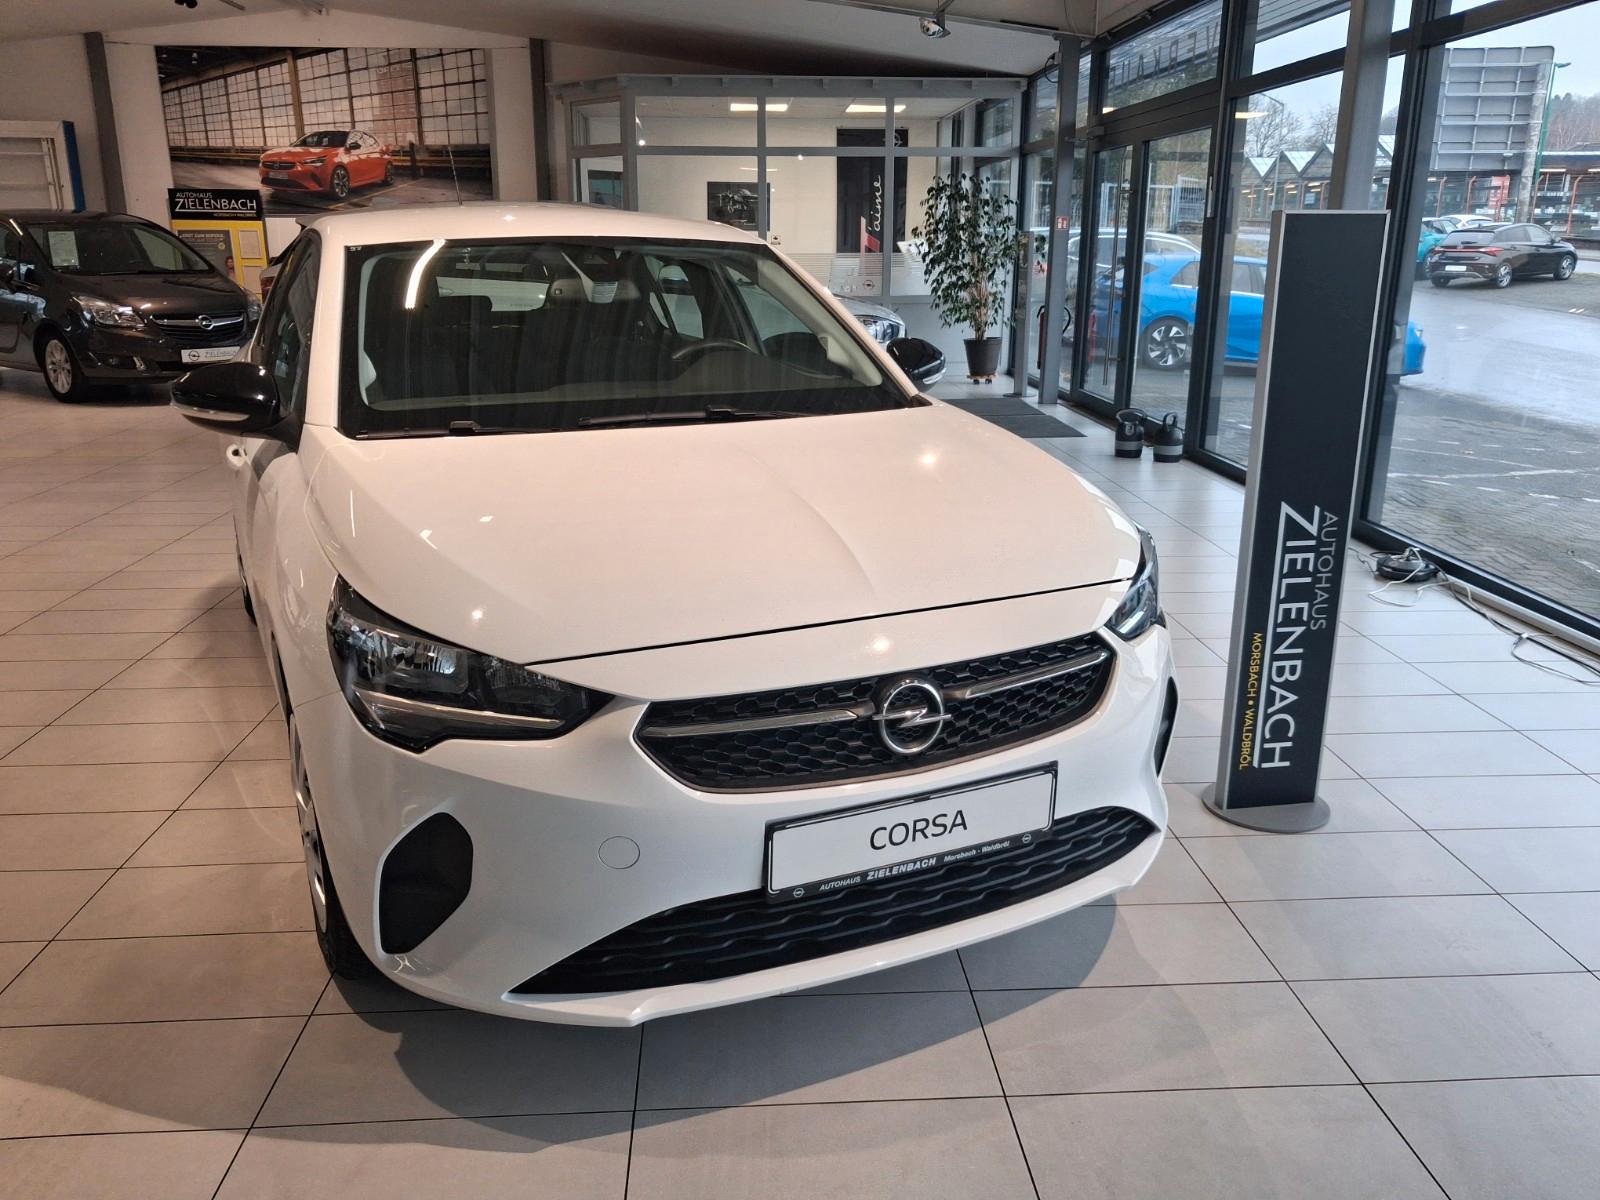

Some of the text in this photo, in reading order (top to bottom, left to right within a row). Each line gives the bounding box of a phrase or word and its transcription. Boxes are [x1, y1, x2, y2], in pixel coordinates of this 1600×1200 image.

[175, 199, 257, 212] ZIELENBACH
[1309, 511, 1339, 631] AUTOHAUS
[1247, 632, 1262, 698] MORSBACH
[1253, 501, 1321, 768] ZIELENBACH
[1239, 708, 1254, 770] WALDBRÖL
[870, 809, 968, 850] CORSA
[819, 875, 861, 891] AUTOHAUS
[867, 857, 936, 880] ZIELENBACH
